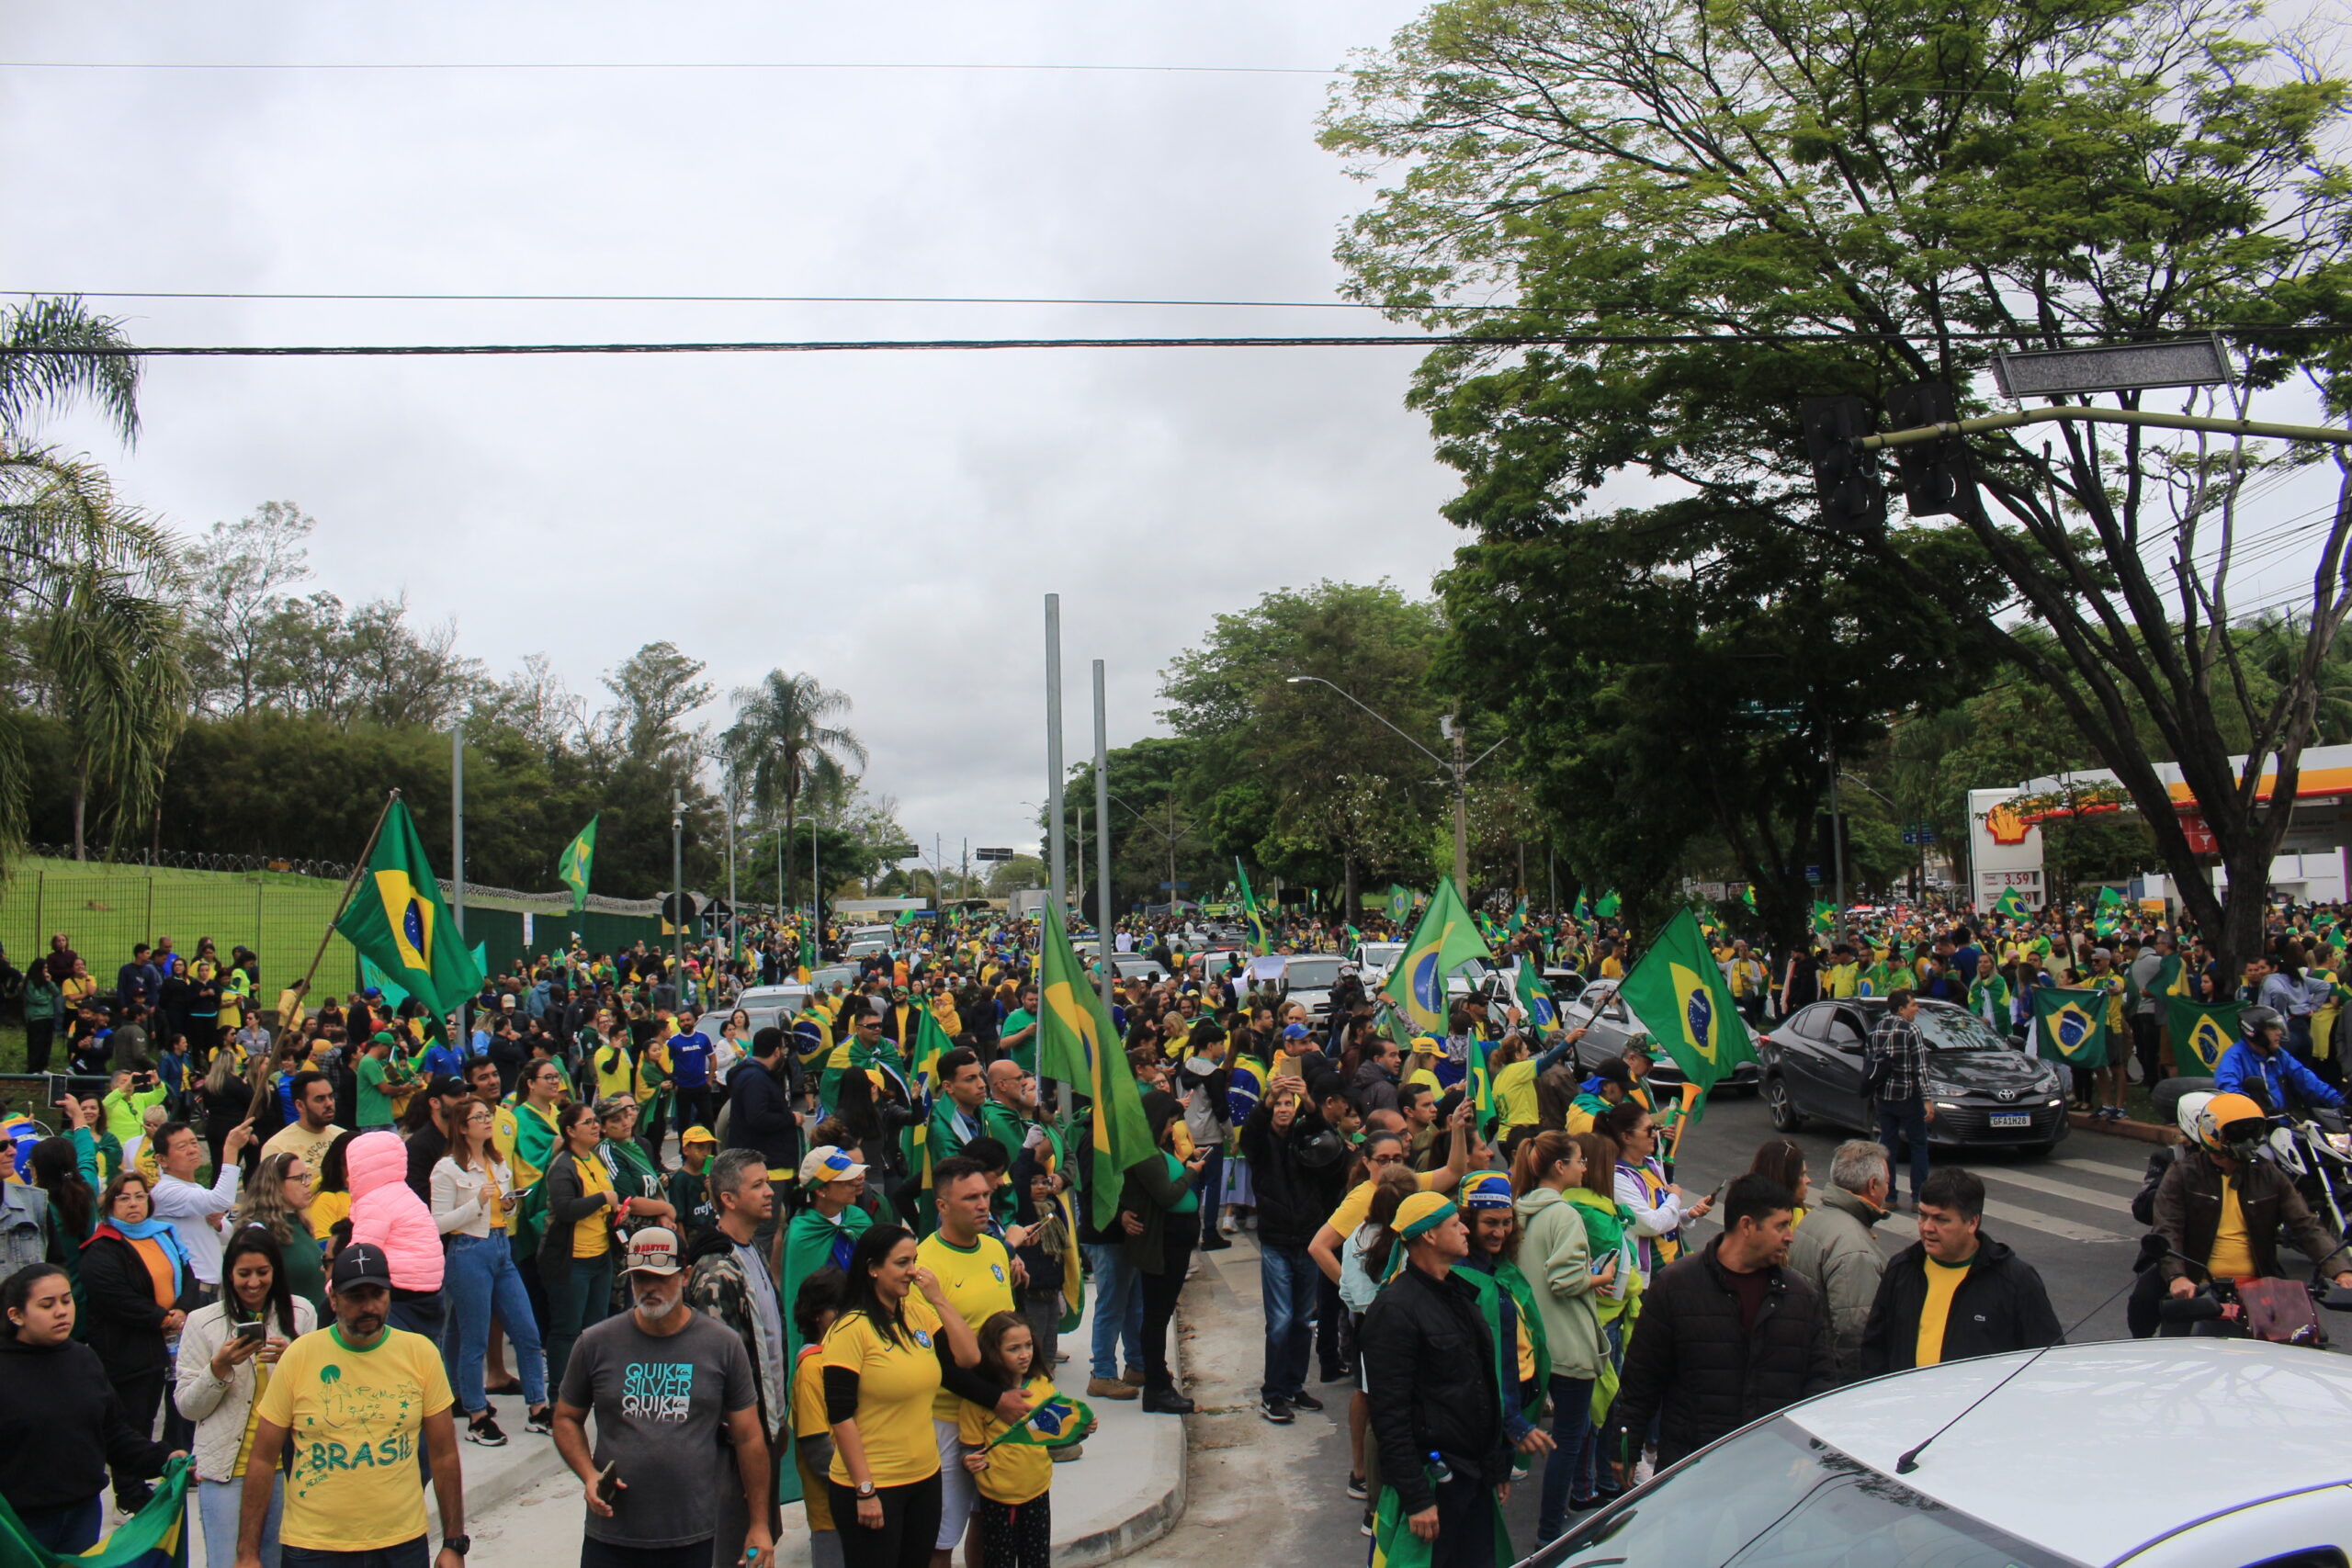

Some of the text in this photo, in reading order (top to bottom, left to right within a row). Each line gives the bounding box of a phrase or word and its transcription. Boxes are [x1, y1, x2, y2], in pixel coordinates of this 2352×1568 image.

[2005, 873, 2030, 886] 3.59
[626, 1362, 676, 1379] QUIK
[623, 1378, 692, 1396] SILVER
[622, 1395, 673, 1412] QUIK
[311, 1431, 413, 1472] BRASIL
